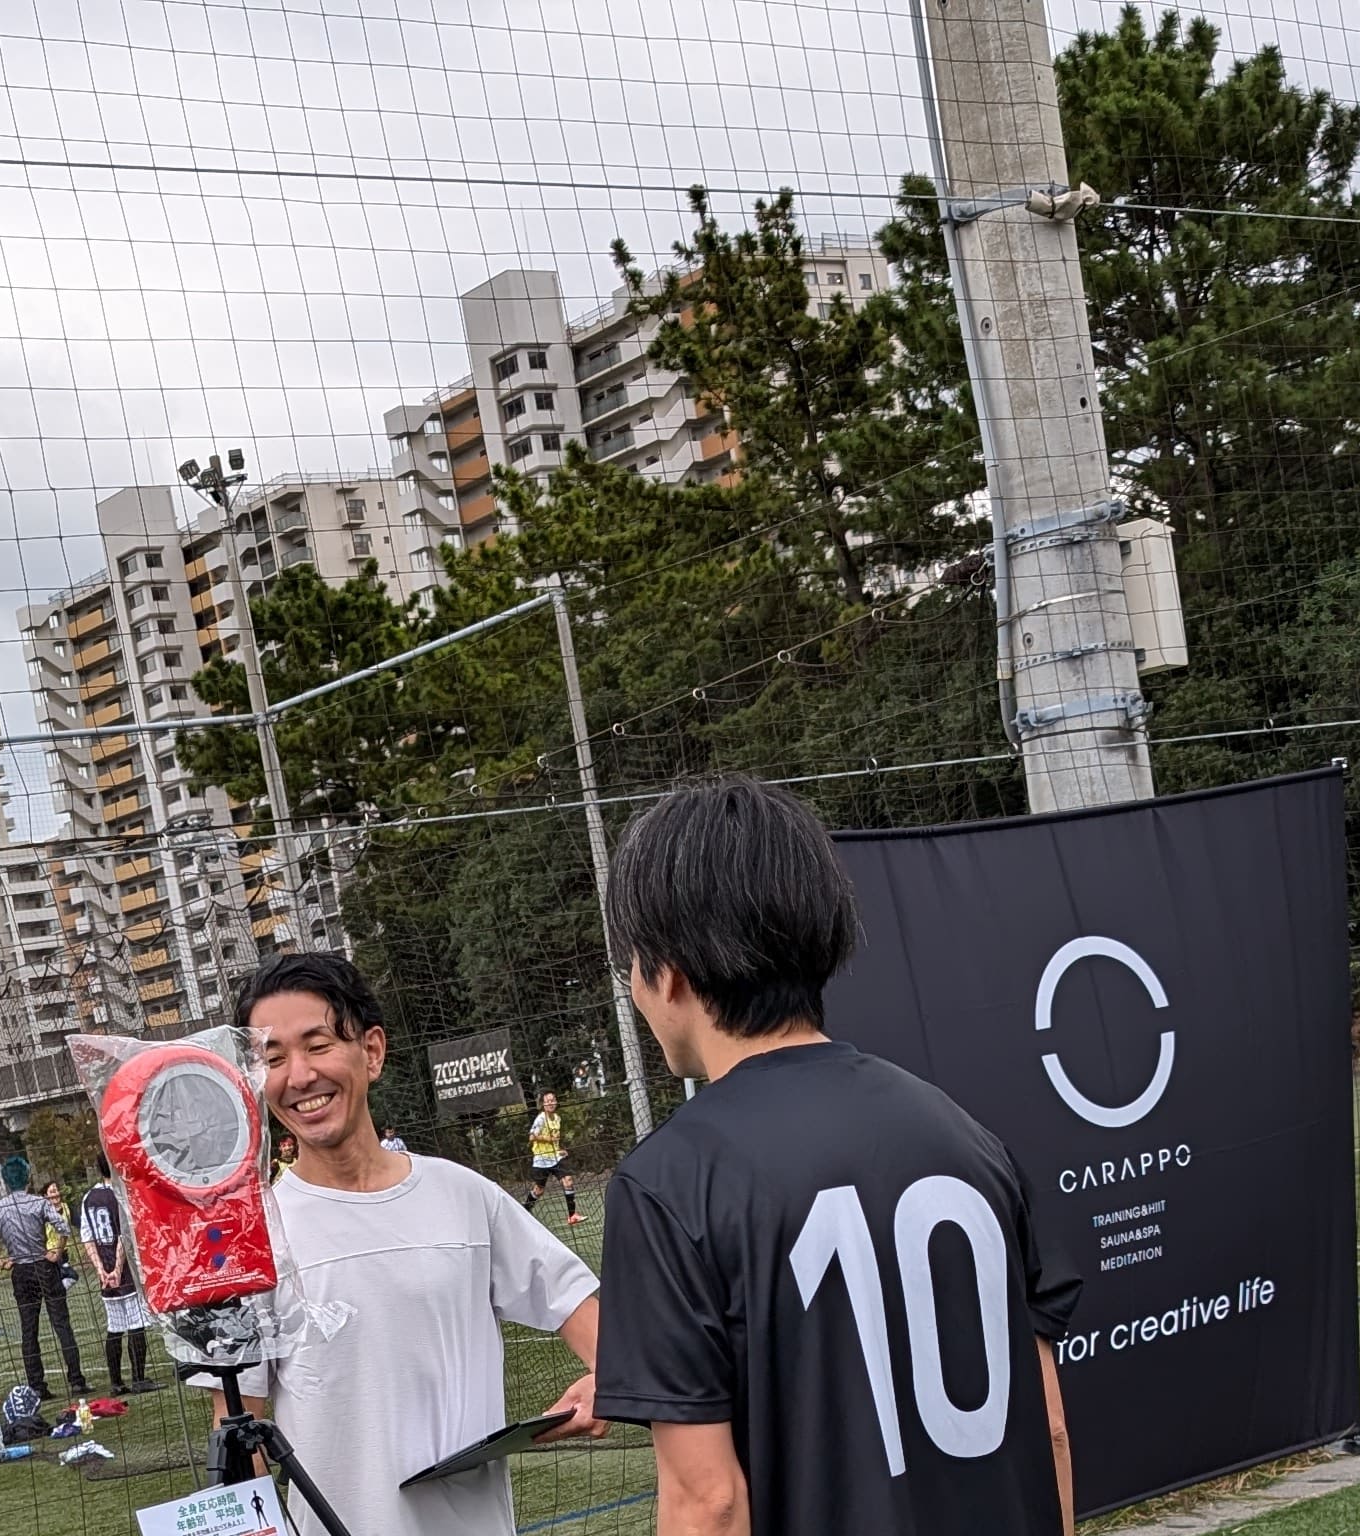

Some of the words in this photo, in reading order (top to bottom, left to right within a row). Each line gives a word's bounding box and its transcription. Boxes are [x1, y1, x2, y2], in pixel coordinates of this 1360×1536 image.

[433, 1048, 510, 1087] ZOZOPARK
[1059, 1144, 1191, 1193] CARAPPO
[88, 1206, 114, 1246] 18
[1093, 1200, 1166, 1228] TRAINING&HIIT
[1100, 1224, 1161, 1249] SAUNA&SPA
[1100, 1245, 1163, 1272] MEDITATION
[789, 1175, 1010, 1477] 10
[1057, 1329, 1100, 1365] for
[1110, 1294, 1231, 1350] creative
[1238, 1276, 1276, 1313] life
[177, 1491, 238, 1519] 全身反応時間
[215, 1503, 246, 1521] 平均値
